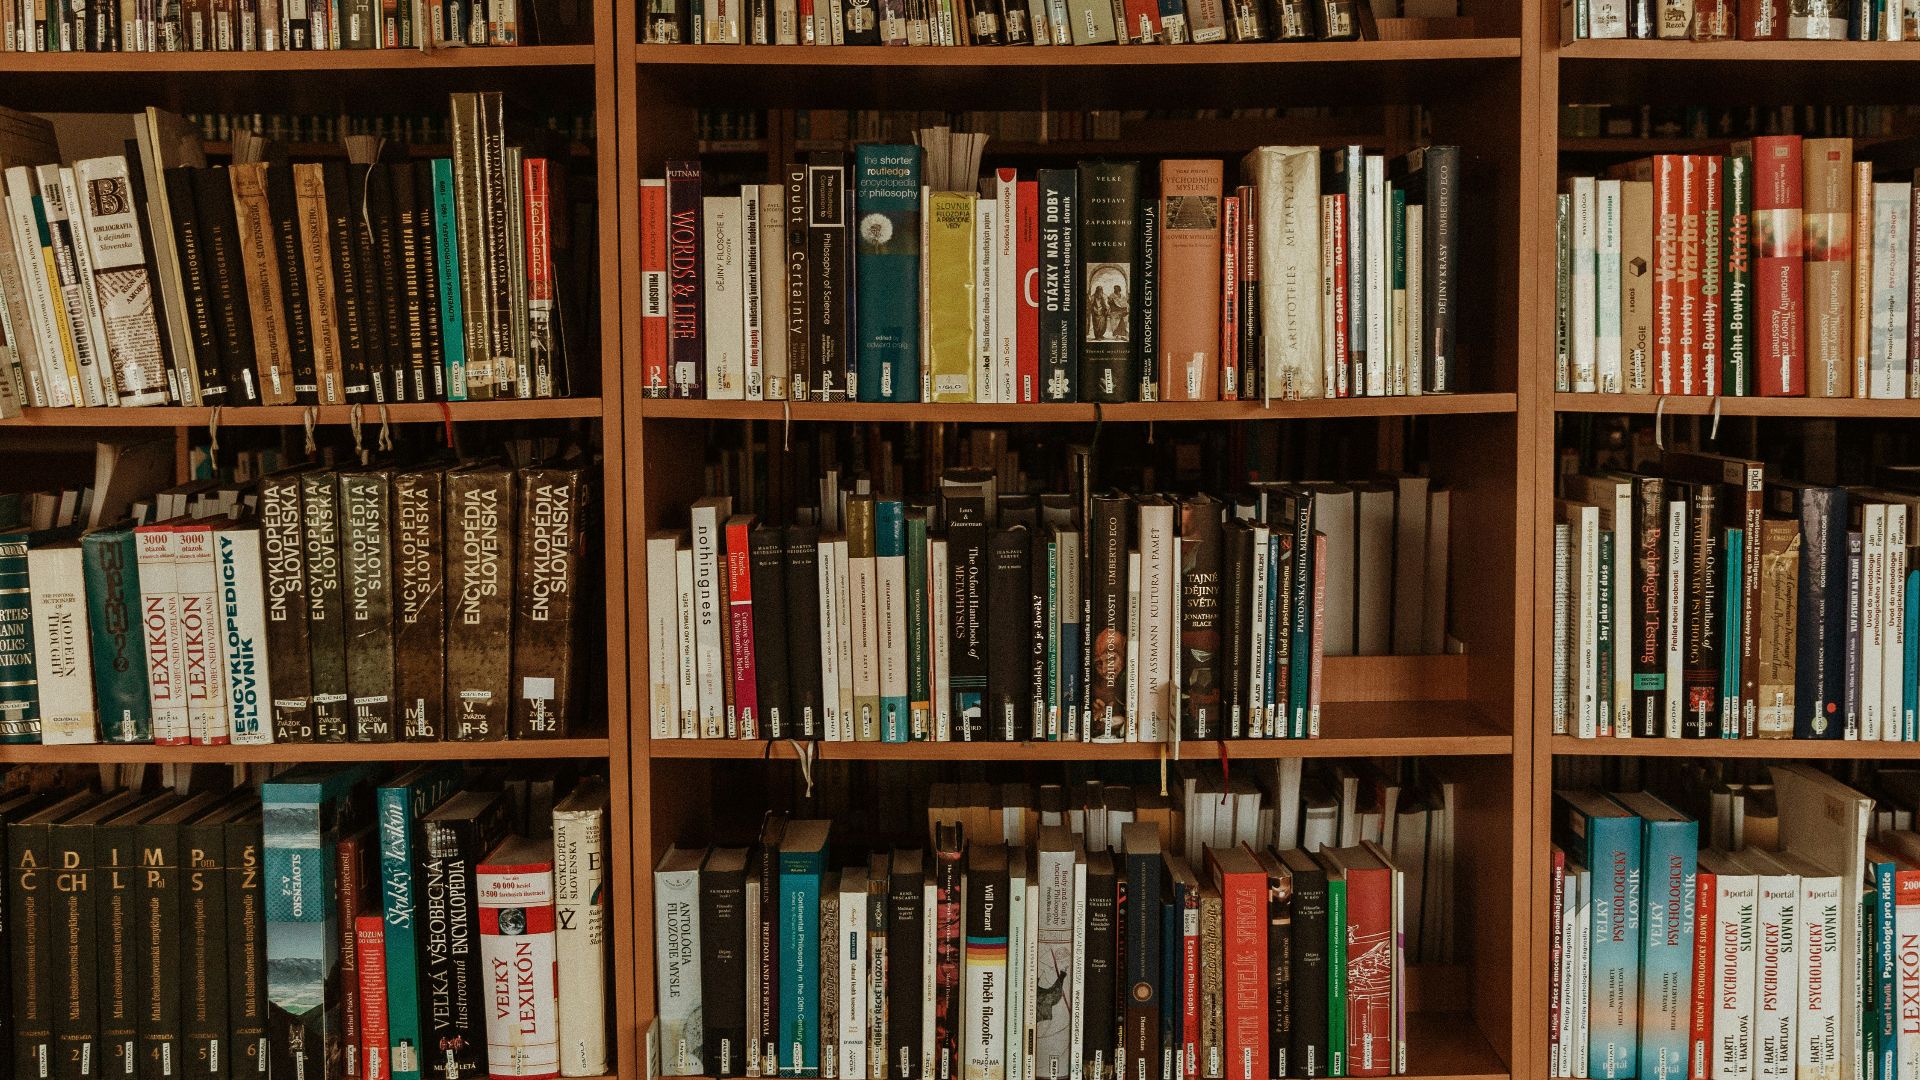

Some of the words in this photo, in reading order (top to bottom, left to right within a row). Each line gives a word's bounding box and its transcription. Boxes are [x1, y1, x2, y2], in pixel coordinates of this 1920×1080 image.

[861, 177, 916, 188] encyclopedia
[864, 156, 877, 165] the
[880, 156, 913, 165] shorter
[867, 166, 911, 177] routledge
[531, 201, 543, 226] Real
[791, 172, 804, 223] Doubt
[859, 189, 868, 198] of
[869, 189, 918, 200] philosophy
[1047, 188, 1058, 222] DOBY
[1143, 207, 1154, 217] JÁ
[1440, 187, 1448, 235] UMBERTO
[533, 230, 544, 275] Science
[672, 211, 696, 279] WORDS
[822, 233, 832, 279] Philosophy
[1045, 229, 1059, 257] NAŠÍ
[1141, 219, 1153, 270] VLASTNÍMU
[1437, 243, 1447, 276] KRÁSY
[1655, 213, 1677, 282] Vazba
[1677, 214, 1698, 282] Vazba
[1701, 210, 1720, 296] Odloučení
[1728, 214, 1748, 273] Ztráta
[649, 273, 658, 315] PHILOSOPHY
[672, 283, 696, 298] &
[791, 251, 806, 334] Certainty
[823, 291, 832, 325] Science
[1045, 264, 1059, 312] OTÁZKY
[1143, 279, 1153, 306] CESTY
[1437, 278, 1447, 314] DĚJINY
[1728, 281, 1745, 330] Bowlby
[66, 288, 92, 366] CHRONOLÓGIA
[673, 302, 696, 340] LIFE
[1140, 308, 1152, 353] EVROPSKÉ
[1658, 294, 1673, 345] Bowlby
[1680, 295, 1694, 345] Bowlby
[1702, 302, 1718, 350] Bowlby
[1772, 310, 1780, 358] Assessment
[1730, 334, 1743, 363] John
[144, 535, 167, 544] 3000
[180, 535, 204, 544] 3000
[282, 484, 302, 592] SLOVENSKA
[319, 485, 337, 590] SLOVENSKA
[365, 485, 382, 590] SLOVENSKA
[415, 488, 431, 593] SLOVENSKA
[481, 489, 498, 596] SLOVENSKA
[551, 485, 569, 593] SLOVENSKA
[1109, 517, 1117, 536] ECO
[1298, 508, 1308, 551] MRTVÝCH
[1705, 537, 1715, 555] The
[262, 485, 287, 621] ENCYKLOPÉDIA
[305, 485, 325, 620] ENCYKLOPÉDIA
[351, 485, 368, 620] ENCYKLOPÉDIA
[400, 488, 417, 623] ENCYKLOPÉDIA
[461, 488, 481, 625] ENCYKLOPÉDIA
[531, 484, 553, 621] ENCYKLOPÉDIA
[698, 526, 713, 625] nothingness
[968, 546, 979, 565] The
[1108, 538, 1117, 585] UMBERTO
[1298, 553, 1307, 581] KNIHA
[1600, 564, 1609, 586] duše
[1641, 528, 1661, 613] Psychological
[1691, 517, 1702, 595] EVOLUTIONARY
[1705, 556, 1716, 588] Oxford
[955, 565, 965, 639] METAPHYSICS
[968, 567, 979, 598] Oxford
[1599, 587, 1608, 602] řeč
[968, 600, 979, 647] Handbook
[1106, 594, 1116, 650] OŠKLIVOSTI
[1295, 583, 1305, 633] PLATONSKÁ
[1600, 604, 1610, 623] jako
[1689, 599, 1701, 665] PSYCHOLOGY
[1703, 590, 1715, 637] Handbook
[48, 612, 63, 678] THOUGHT
[63, 612, 75, 678] MODERN
[145, 596, 171, 701] LEXIKÓN
[181, 596, 207, 700] LEXIKÓN
[218, 535, 245, 732] ENCYKLOPEDICKÝ
[967, 648, 980, 660] of
[1599, 625, 1609, 641] Sny
[1641, 616, 1660, 664] Testing
[1702, 639, 1713, 651] of
[240, 637, 259, 732] SLOVNÍK
[1106, 653, 1115, 687] DĚJINY
[143, 848, 164, 865] M
[383, 803, 407, 863] lexikón
[57, 874, 87, 891] CH
[64, 851, 80, 868] D
[291, 854, 302, 917] SLOVENSKO
[386, 867, 415, 928] Školský
[448, 859, 469, 954] ENCYKLOPÉDIA
[984, 884, 994, 901] Will
[1612, 850, 1626, 942] PSYCHOLOGICKÝ
[1626, 868, 1640, 929] SLOVNÍK
[1667, 854, 1681, 946] PSYCHOLOGICKÝ
[1682, 873, 1695, 934] SLOVNÍK
[422, 859, 448, 964] VŠEOBECNÁ
[667, 903, 679, 959] FILOZOFIE
[680, 902, 693, 965] ANTOLÓGIA
[984, 903, 994, 931] Durant
[1595, 899, 1608, 943] VELKÝ
[1650, 901, 1663, 947] VELKÝ
[1698, 914, 1707, 943] SLOVNÍK
[1737, 904, 1753, 952] SLOVNÍK
[1779, 905, 1793, 953] SLOVNÍK
[1822, 904, 1837, 952] SLOVNÍK
[669, 961, 680, 998] MYSLE
[1187, 940, 1195, 971] Eastern
[1695, 944, 1706, 999] PSYCHOLOGICKÝ
[1722, 920, 1738, 1010] PSYCHOLOGICKÝ
[1763, 922, 1779, 1011] PSYCHOLOGICKÝ
[1806, 922, 1822, 1010] PSYCHOLOGICKÝ
[453, 960, 469, 1029] ilustrovaná
[495, 957, 511, 1020] VEĽKÝ
[516, 942, 536, 1036] LEXIKÓN
[981, 971, 994, 1003] Příběh
[1185, 973, 1195, 1016] Philosophy
[1899, 934, 1920, 1035] LEXIKÓN
[982, 1006, 994, 1046] filozofie
[1695, 1001, 1705, 1031] STRUČNÝ
[1738, 1015, 1748, 1060] HARTLOVÁ
[1778, 1016, 1789, 1061] HARTLOVÁ
[1823, 1015, 1835, 1060] HARTLOVÁ
[1724, 1065, 1733, 1073] P.
[1725, 1035, 1734, 1063] HARTL
[1739, 1062, 1747, 1072] H.
[1765, 1035, 1774, 1064] HARTL
[1765, 1066, 1774, 1074] P.
[1779, 1063, 1788, 1074] H.
[1810, 1034, 1820, 1063] HARTL
